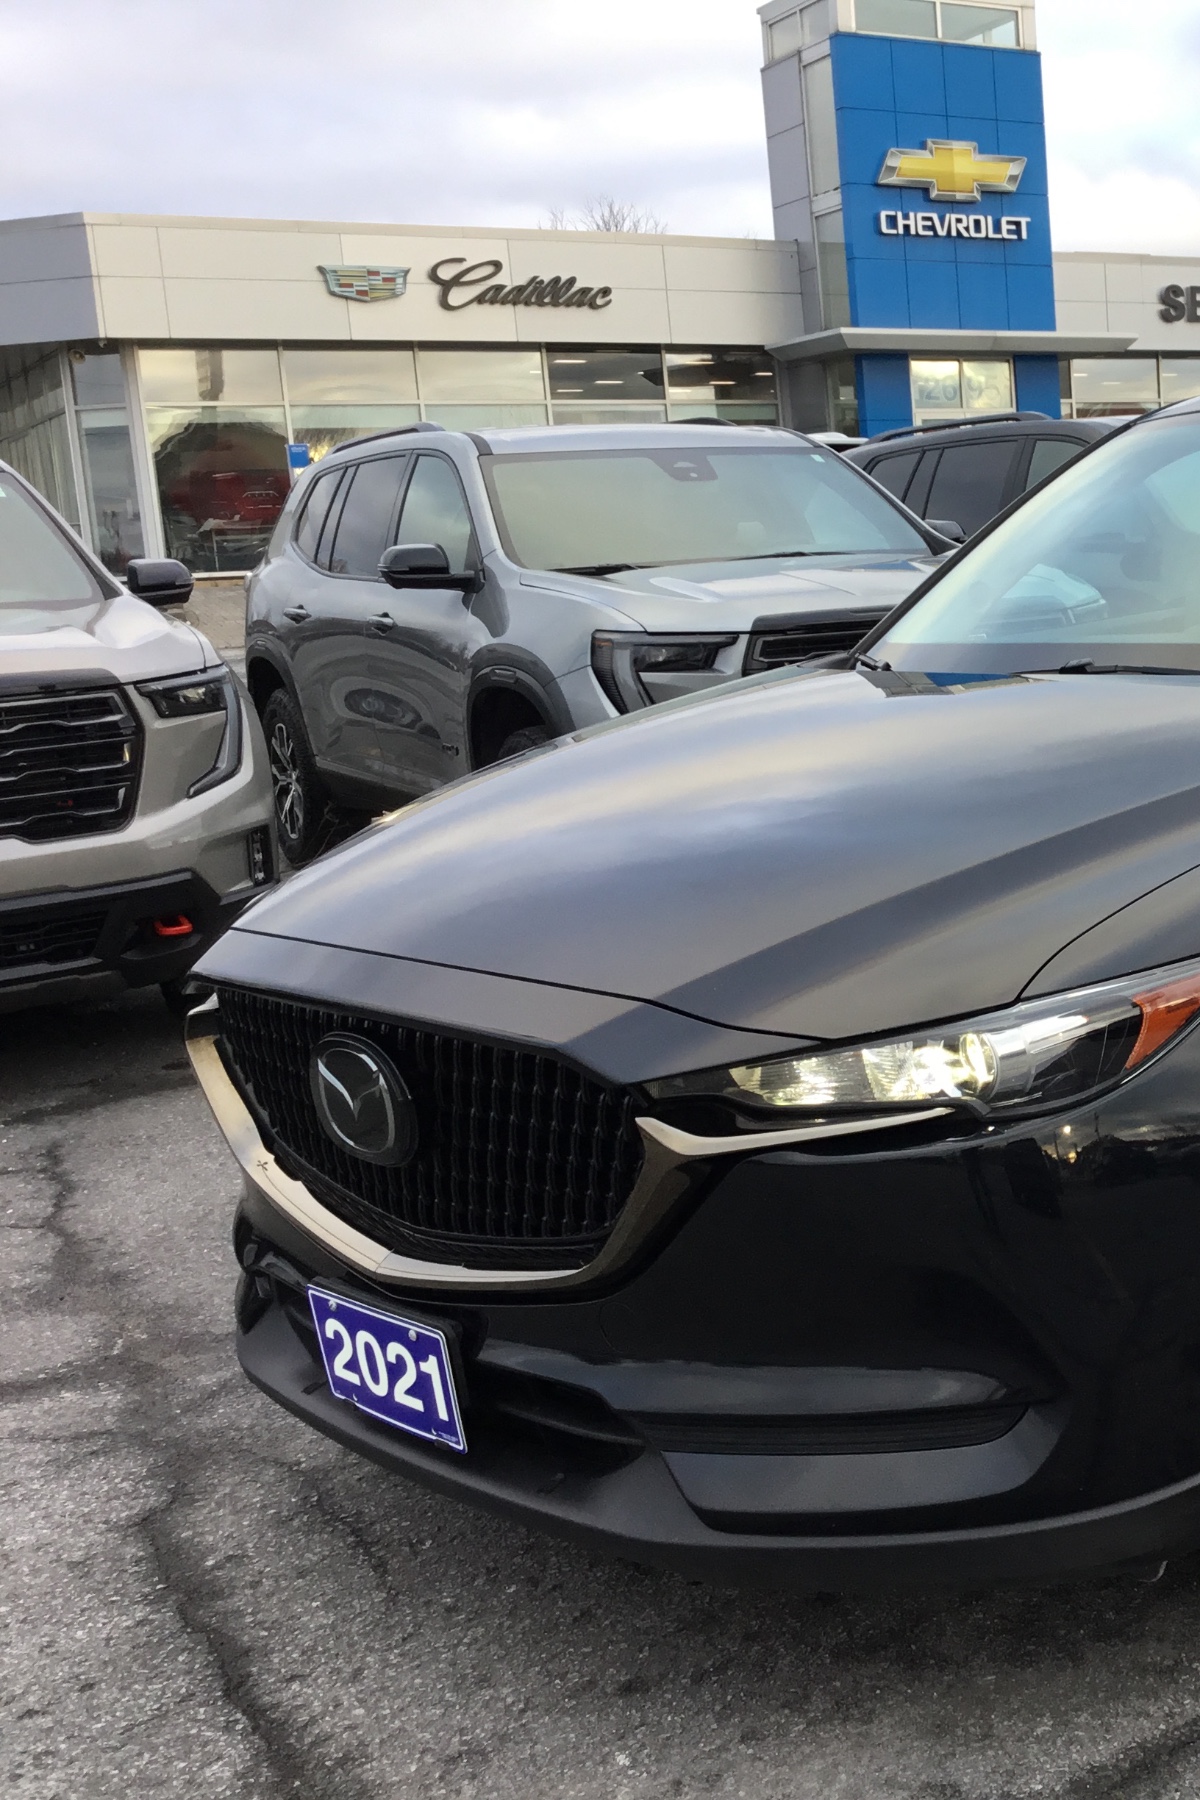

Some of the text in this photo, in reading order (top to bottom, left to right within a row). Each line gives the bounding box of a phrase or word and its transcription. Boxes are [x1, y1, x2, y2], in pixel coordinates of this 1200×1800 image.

[880, 210, 1031, 240] CHEVROLET
[428, 257, 612, 311] Cadillac
[324, 1318, 450, 1422] 2021
